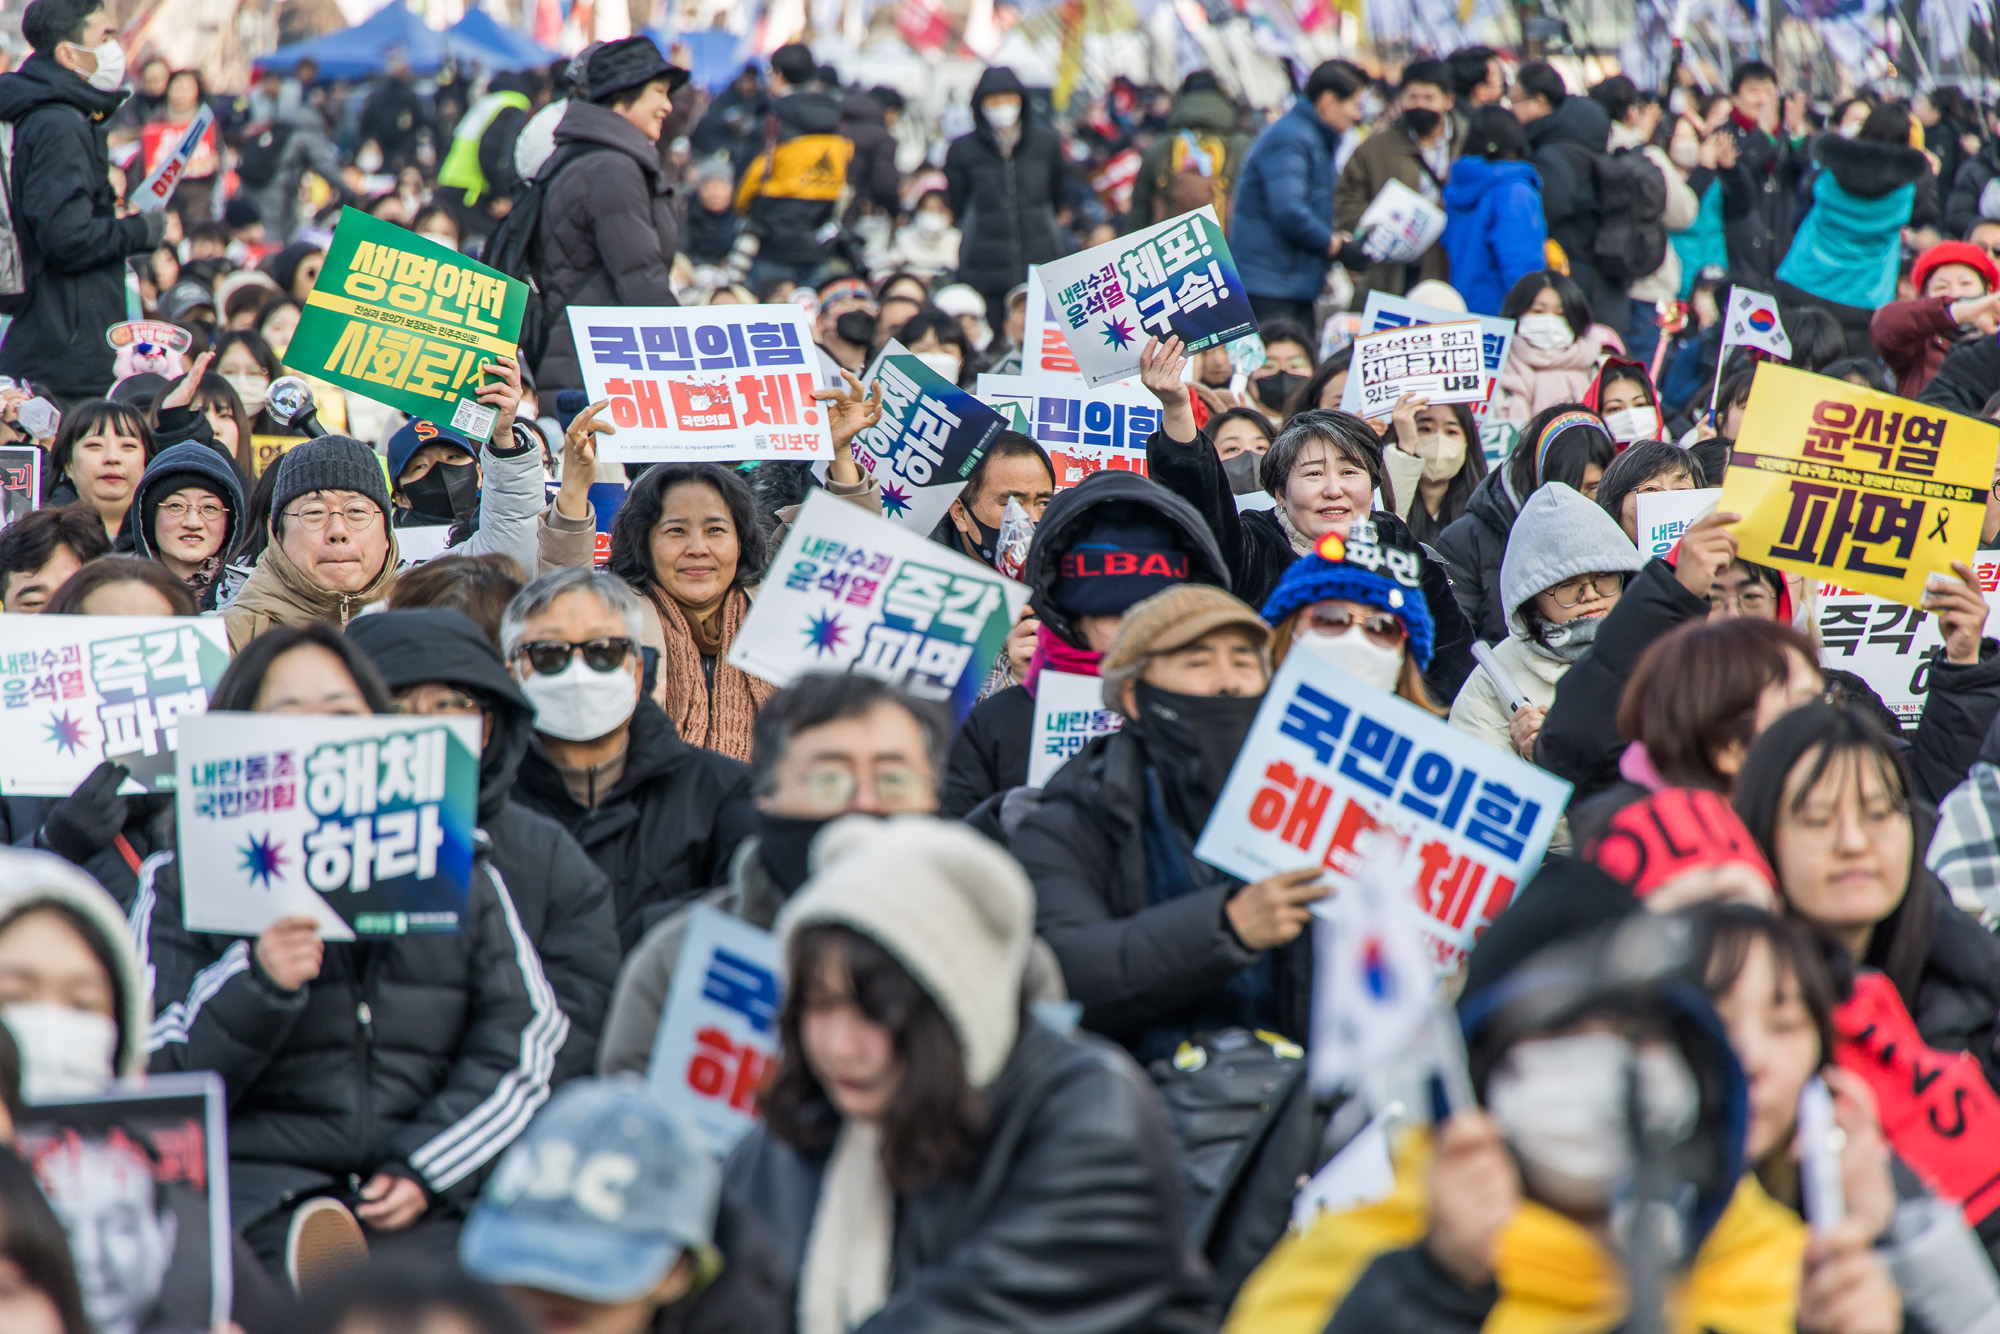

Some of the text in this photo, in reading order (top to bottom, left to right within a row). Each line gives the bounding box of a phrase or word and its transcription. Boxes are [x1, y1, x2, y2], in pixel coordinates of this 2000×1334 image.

[1121, 216, 1212, 294] 체포!
[343, 240, 508, 334] 생명안전
[1057, 262, 1118, 306] 내란수괴
[1066, 281, 1126, 330] 윤석열
[1138, 260, 1229, 335] 구속!
[354, 305, 379, 319] 진실과
[380, 312, 405, 325] 정의가
[406, 318, 437, 334] 보장되는
[1362, 331, 1475, 359] 윤석열 없고
[323, 319, 477, 403] 사회로!
[587, 322, 806, 371] 국민의힘
[1363, 348, 1479, 385] 차별금지법
[604, 372, 820, 429] 해 체!
[681, 413, 731, 427] 국민의힘
[1365, 385, 1400, 405] 있는
[768, 433, 820, 452] 진보당
[894, 393, 962, 485] 하라
[1028, 396, 1163, 449] 민의힘
[1802, 400, 1948, 477] 윤석열
[800, 535, 894, 577] 내란수괴
[1768, 479, 1927, 580] 파면
[784, 559, 880, 610] 윤석열
[1345, 540, 1419, 587] 파면
[890, 563, 1002, 644] 즉각
[1818, 603, 1928, 657] 즉각
[0, 643, 82, 675] 내란수괴
[91, 626, 203, 696] 즉각
[853, 624, 974, 702] 파면
[2, 669, 87, 709] 윤석열
[306, 728, 448, 818] 해체
[1279, 681, 1542, 863] 국민의힘
[193, 781, 297, 822] 국민의힘
[1247, 759, 1334, 853] 해
[304, 803, 444, 894] 하라
